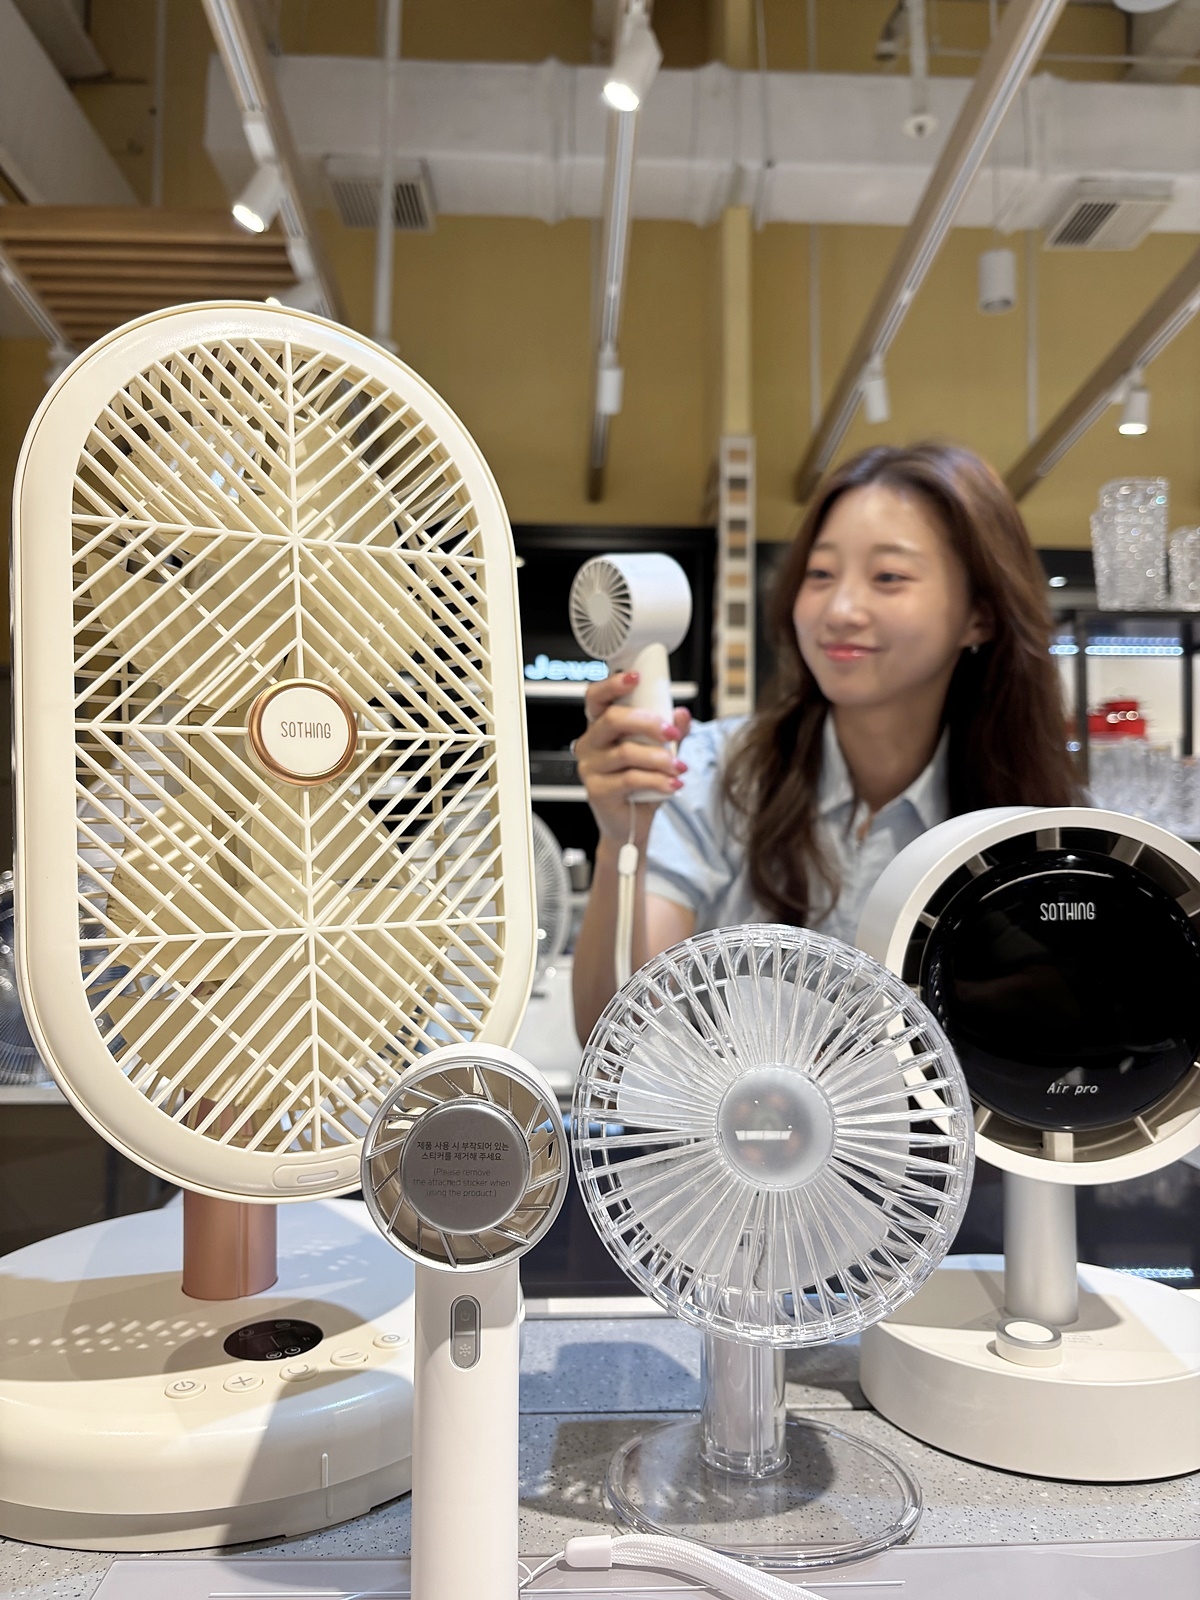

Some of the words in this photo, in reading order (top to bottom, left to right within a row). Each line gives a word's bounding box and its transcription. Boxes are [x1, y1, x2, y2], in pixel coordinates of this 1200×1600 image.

[280, 721, 331, 739] SOTHING
[1040, 902, 1095, 921] SOTHING
[1046, 1082, 1070, 1094] Air
[1074, 1085, 1098, 1096] pro
[417, 1141, 432, 1150] 제품
[435, 1141, 449, 1150] 사용
[452, 1141, 459, 1150] 시
[462, 1142, 492, 1151] 부착되어
[494, 1142, 509, 1151] 있는
[421, 1152, 451, 1161] 스티커를
[454, 1152, 477, 1161] 제거해
[479, 1152, 504, 1161] 주세요.
[433, 1168, 460, 1176] (Please
[413, 1178, 426, 1186] the
[428, 1178, 461, 1186] attached
[463, 1179, 488, 1187] sticker
[490, 1179, 510, 1187] when
[427, 1189, 446, 1198] using
[449, 1189, 461, 1197] the
[463, 1190, 496, 1198] product.)
